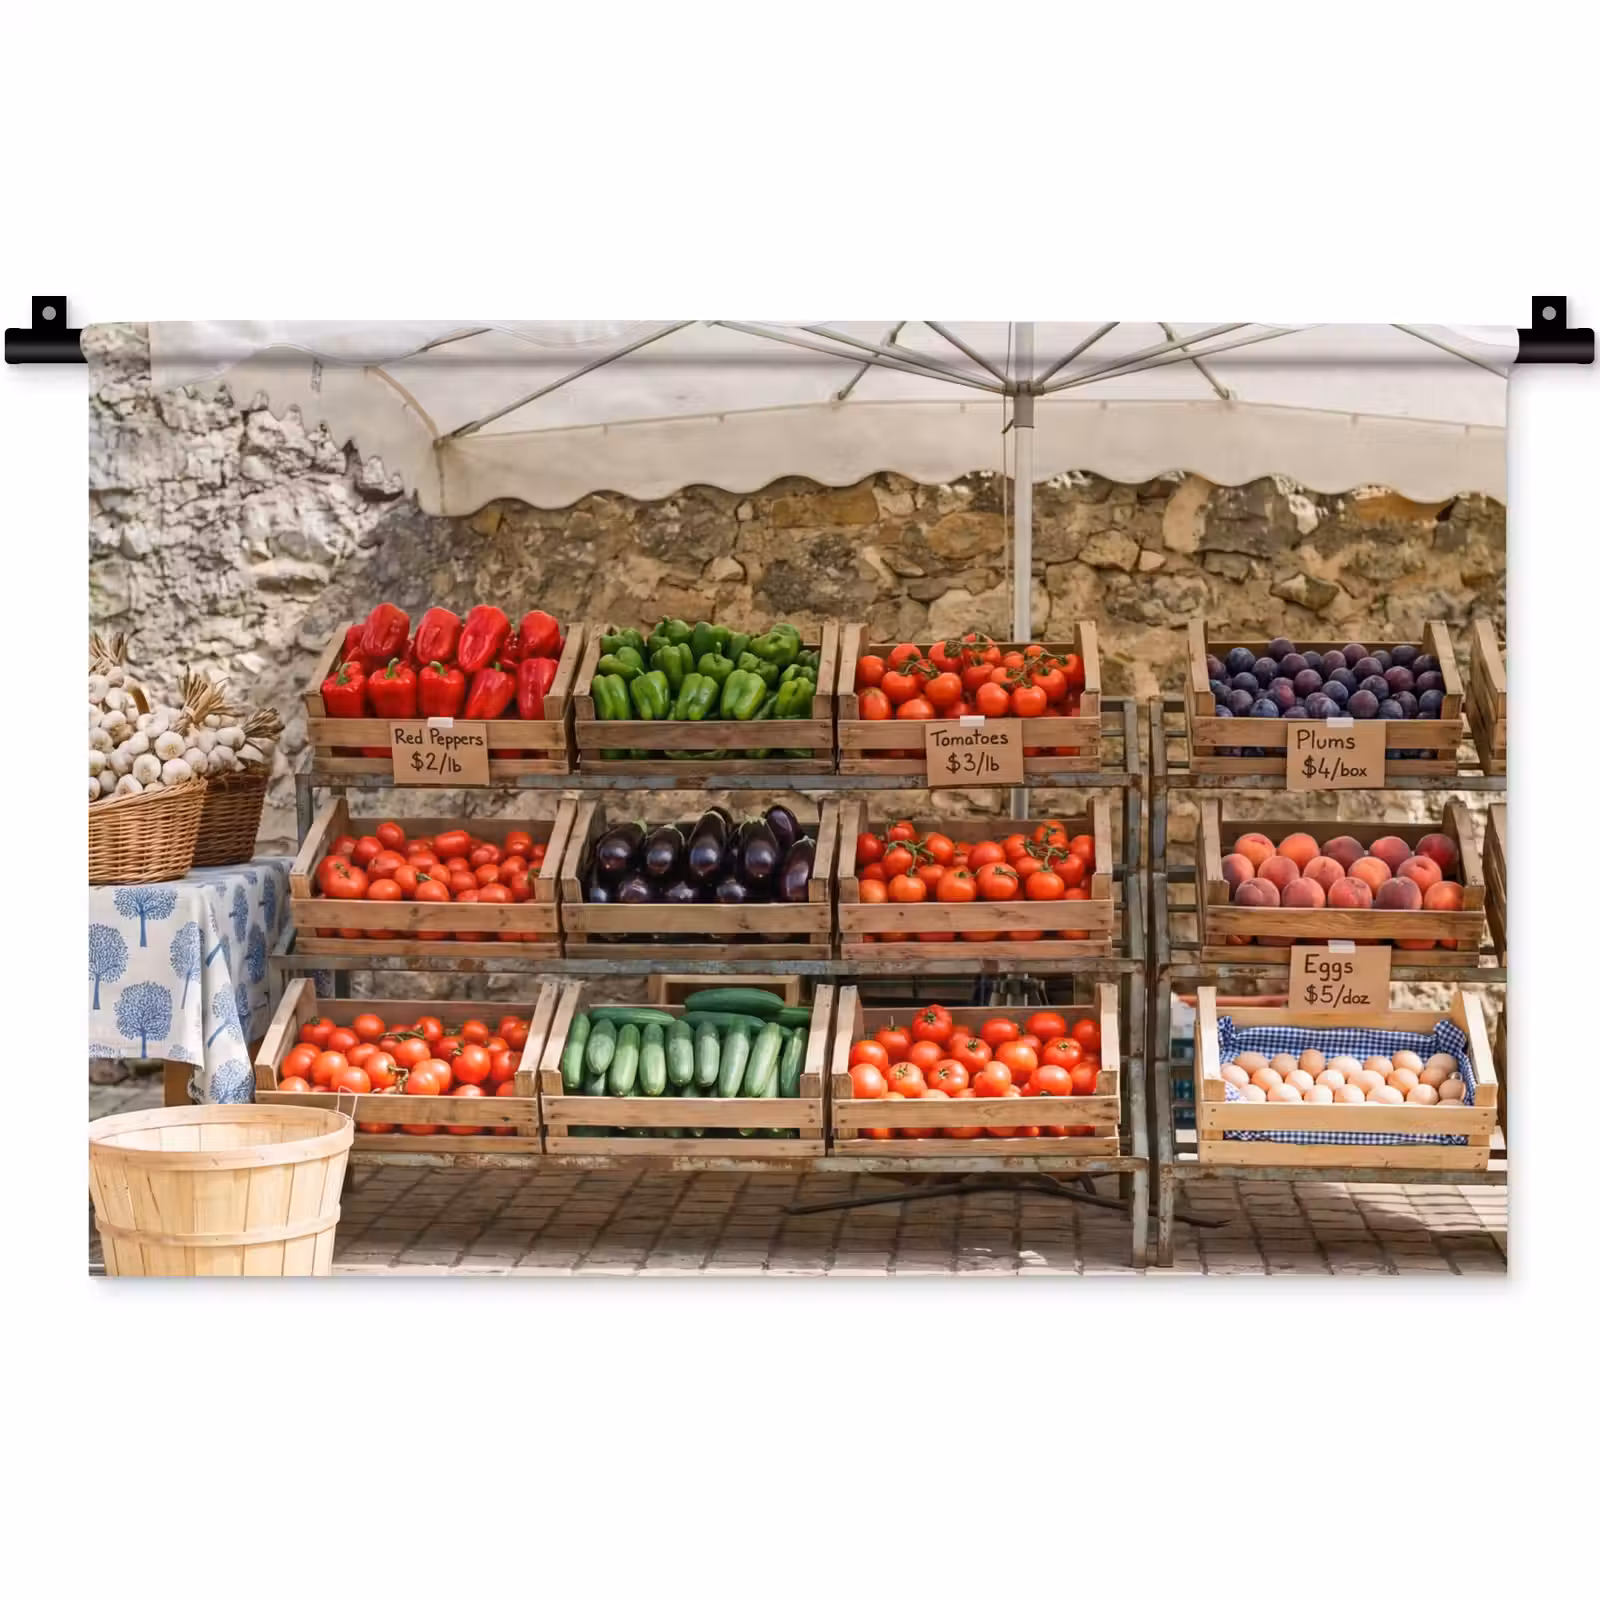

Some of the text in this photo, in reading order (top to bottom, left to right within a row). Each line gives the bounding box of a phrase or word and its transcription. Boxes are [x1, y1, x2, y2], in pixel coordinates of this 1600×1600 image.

[395, 728, 484, 750] Red Peppers
[930, 729, 1009, 747] Tomatoes
[1297, 729, 1356, 750] Plums
[411, 751, 462, 775] $2/lb
[945, 752, 1000, 776] $3/lb
[1302, 755, 1368, 781] $4/box
[1304, 954, 1354, 981] Eggs
[1304, 984, 1371, 1008] $5/doz
